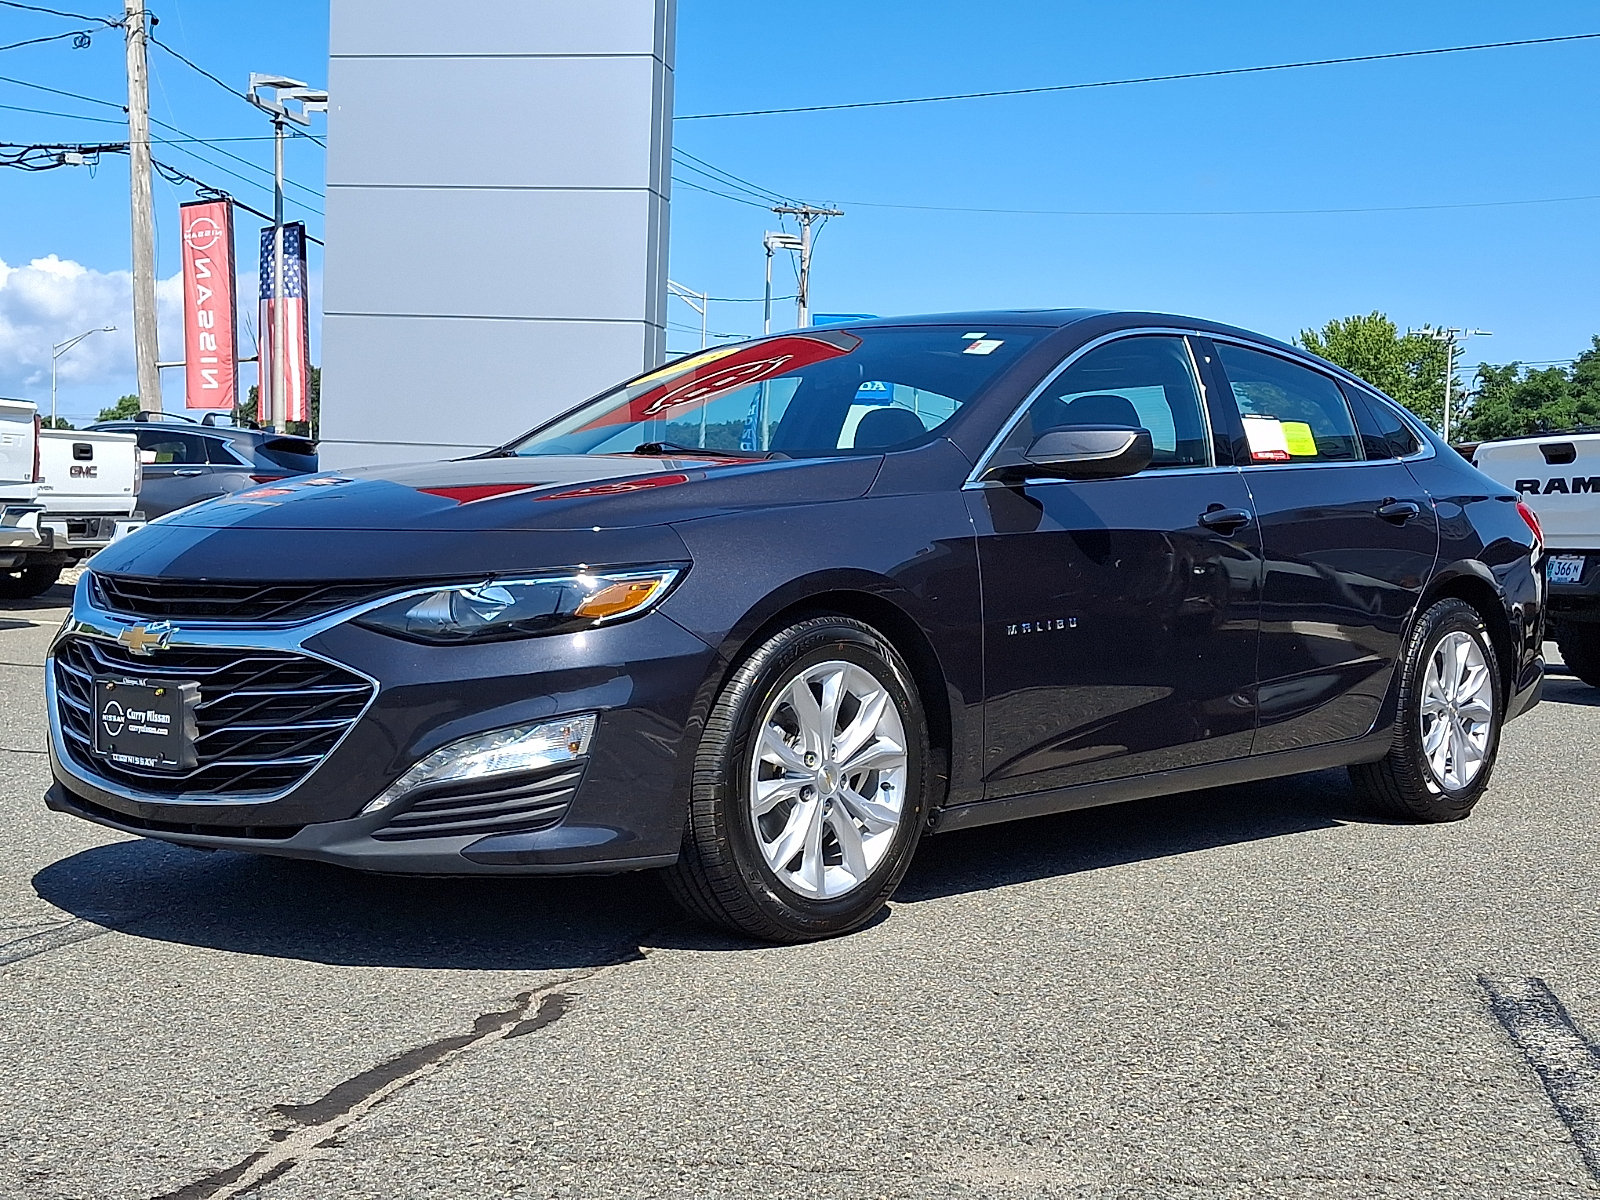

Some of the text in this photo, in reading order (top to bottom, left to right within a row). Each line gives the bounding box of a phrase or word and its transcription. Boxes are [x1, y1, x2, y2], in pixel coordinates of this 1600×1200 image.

[70, 466, 98, 478] GMC
[1515, 477, 1600, 495] RAM
[1007, 617, 1077, 635] MALIBU
[102, 713, 125, 723] NISSAN
[126, 707, 170, 724] Curry Nissan
